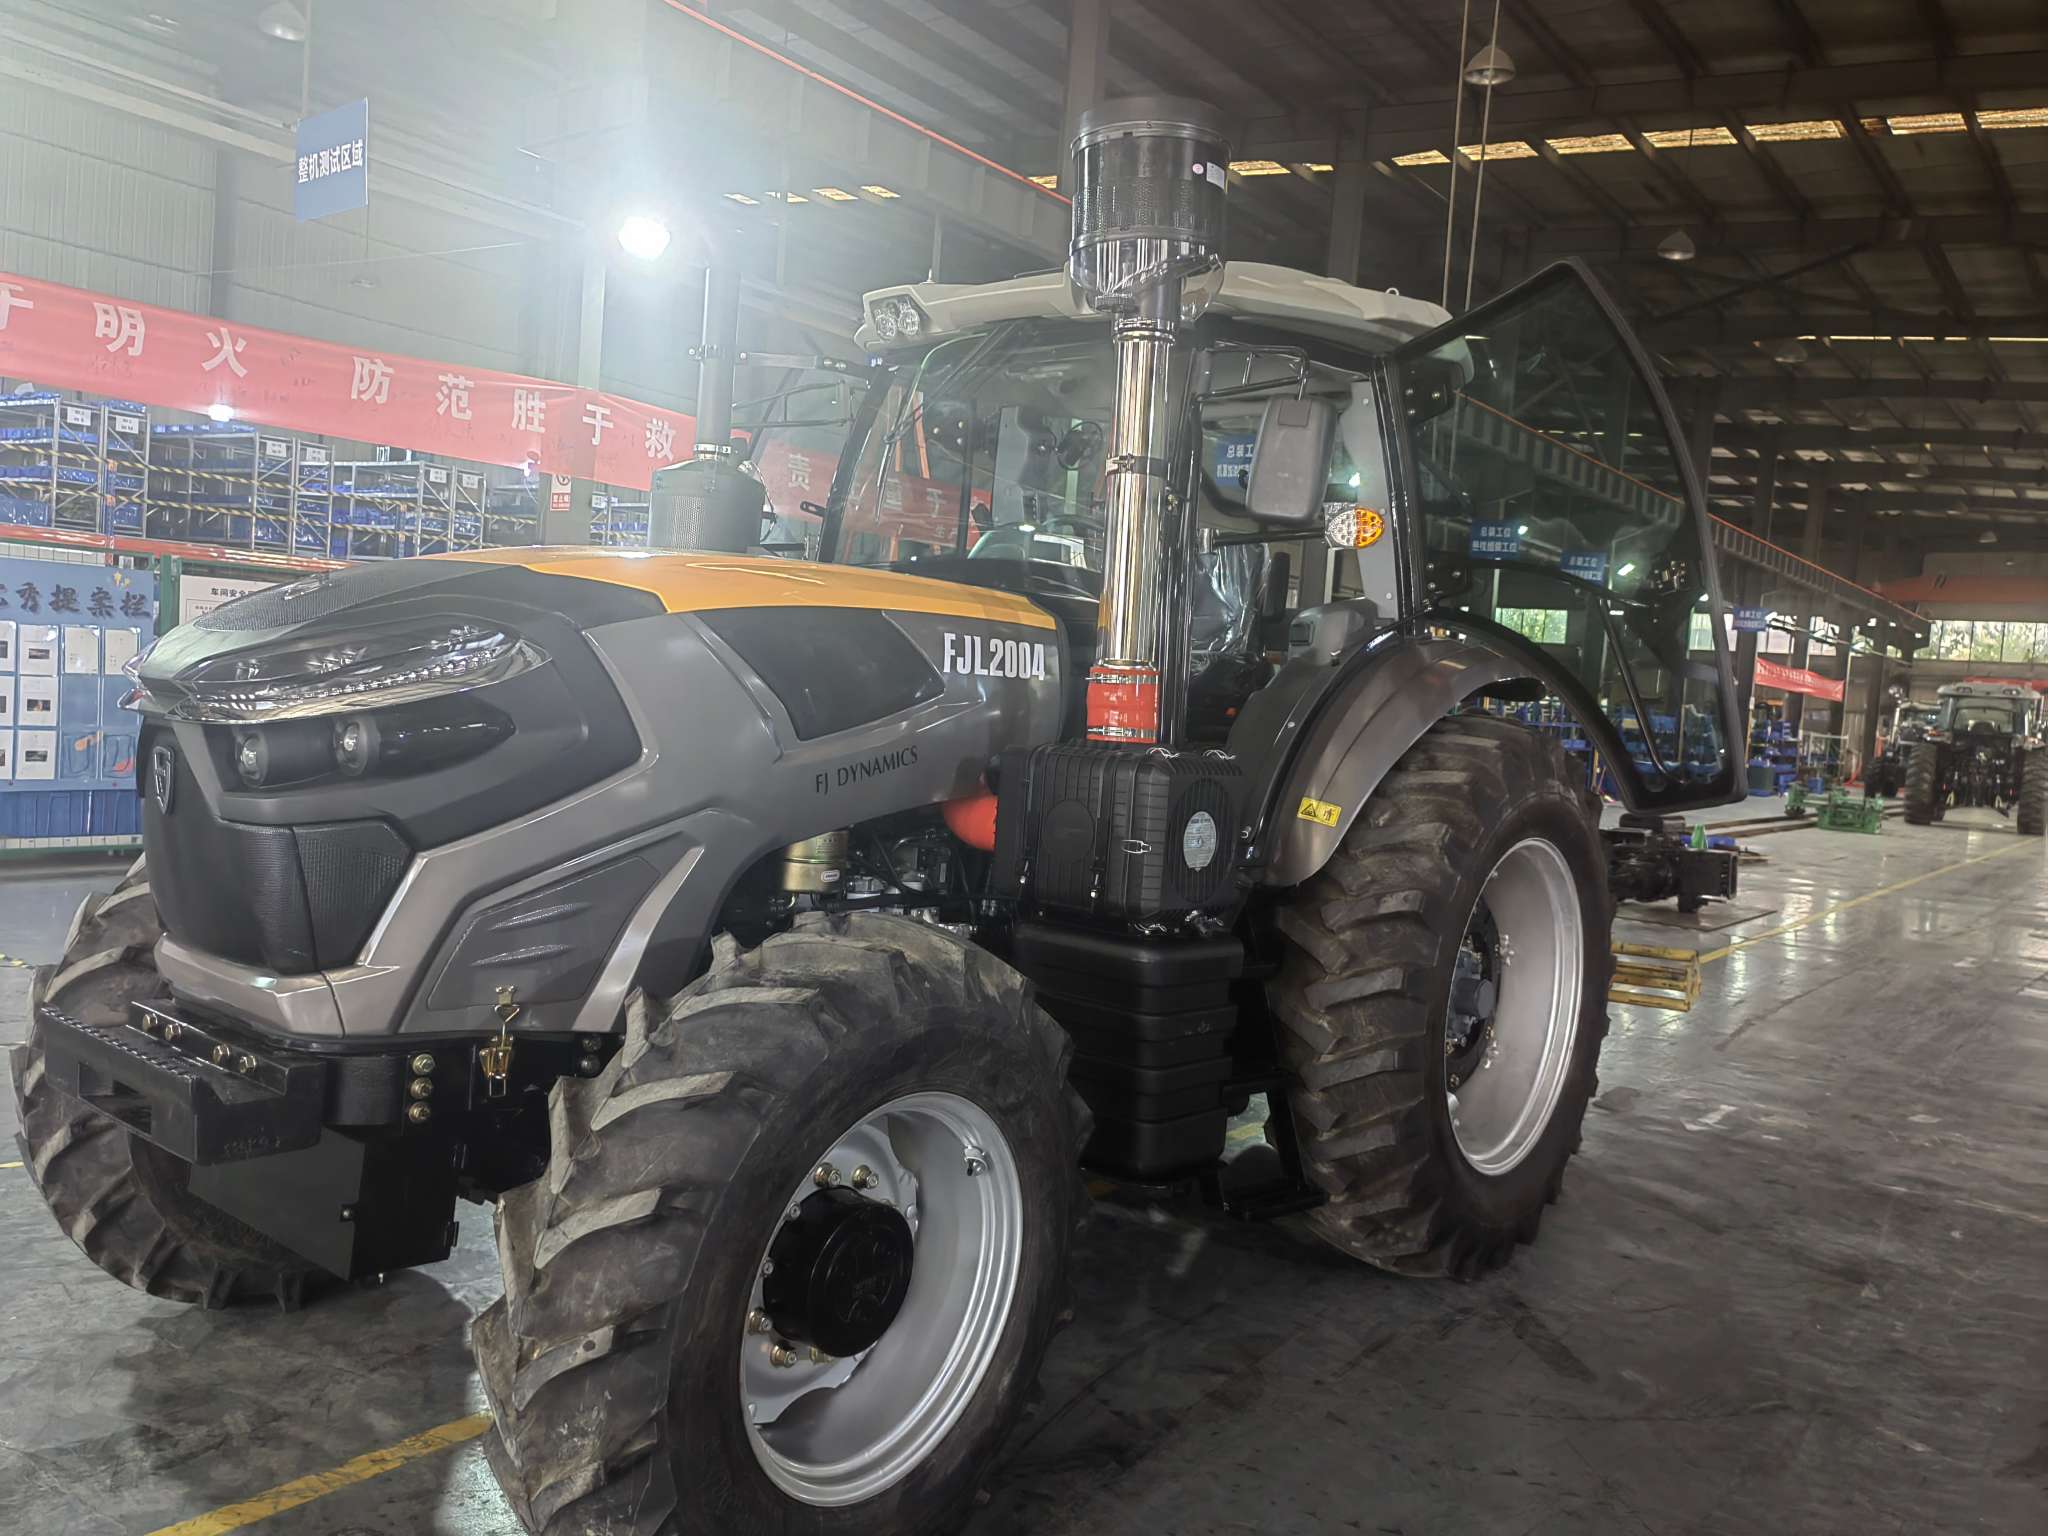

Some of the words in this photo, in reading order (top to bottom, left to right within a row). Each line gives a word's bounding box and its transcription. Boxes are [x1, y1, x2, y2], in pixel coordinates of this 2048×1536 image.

[298, 138, 363, 184] 整机测试区域
[210, 588, 252, 597] 车间安全
[943, 632, 1046, 681] FJL2004
[816, 772, 828, 796] FJ
[837, 745, 918, 787] DYNAMICS
